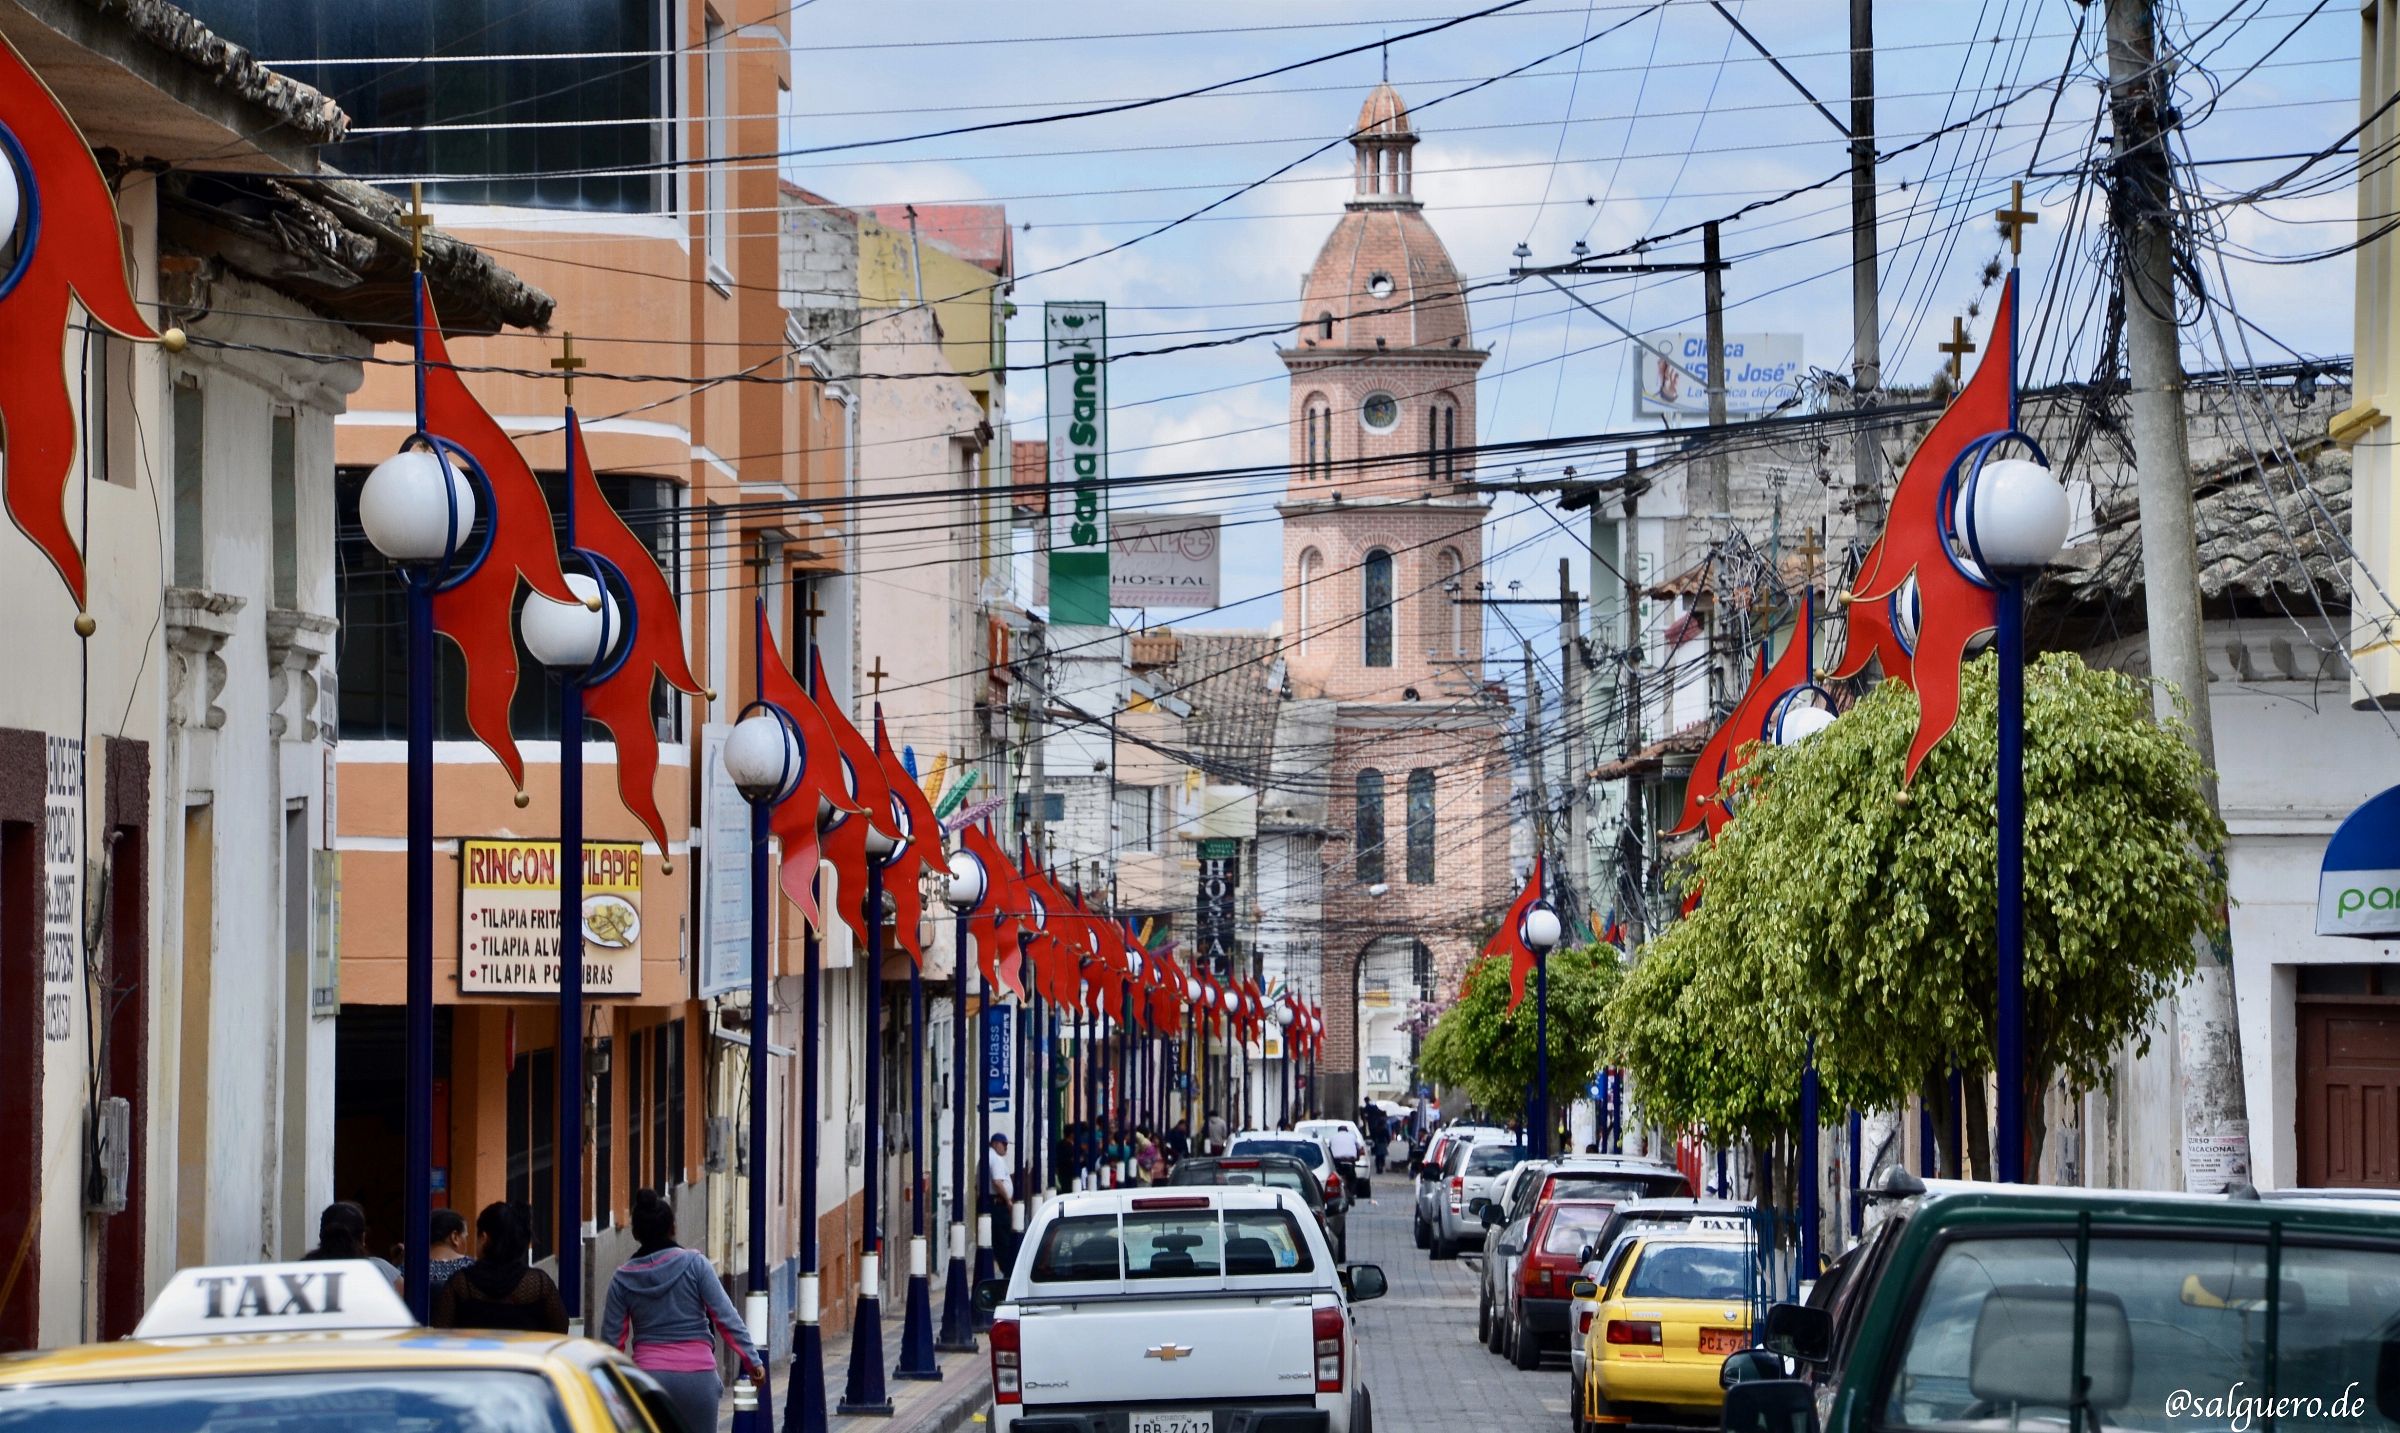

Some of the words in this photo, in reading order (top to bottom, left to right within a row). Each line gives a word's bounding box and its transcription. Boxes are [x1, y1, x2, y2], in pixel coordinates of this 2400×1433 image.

[1683, 338, 1744, 357] Clca
[1069, 353, 1097, 447] Sana
[1071, 452, 1098, 546] Sana
[1112, 575, 1211, 586] HOSTAL
[48, 736, 66, 795] ENDE
[470, 848, 555, 885] RINCON
[481, 907, 527, 929] TILAPIA
[1205, 859, 1226, 976] HOSTAL
[481, 936, 530, 957] TILAPIA
[534, 937, 549, 957] AL
[481, 964, 537, 984] TILAPIA
[544, 965, 561, 984] PO
[582, 965, 613, 985] IBRAS
[1700, 1220, 1745, 1230] TAXI
[195, 1271, 348, 1319] TAXI
